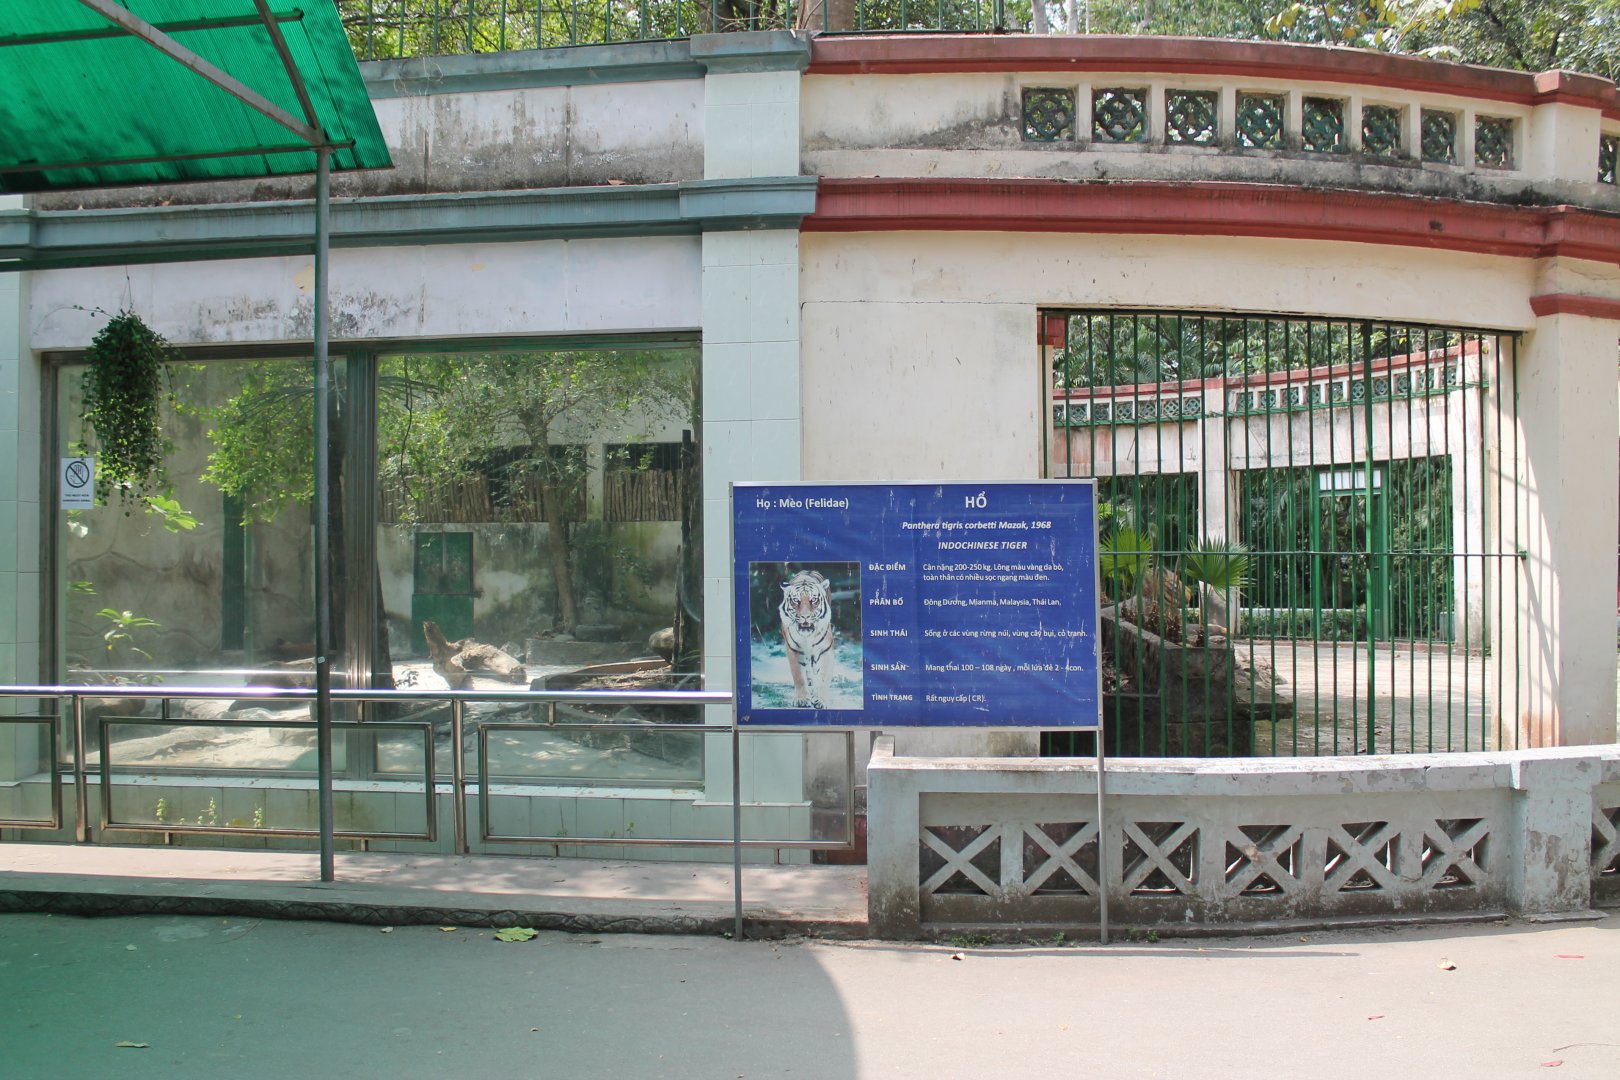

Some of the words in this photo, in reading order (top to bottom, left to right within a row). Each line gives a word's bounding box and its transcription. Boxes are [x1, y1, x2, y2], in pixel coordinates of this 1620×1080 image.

[965, 490, 987, 508] HỔ
[756, 498, 770, 510] Họ
[780, 498, 802, 508] Mèo
[805, 498, 848, 510] (Felidae)
[902, 521, 940, 530] Panthera
[942, 521, 963, 531] tigris
[965, 521, 996, 529] corbetti
[999, 521, 1028, 530] Mazak,
[938, 541, 999, 550] INDOCHINESE
[1001, 541, 1028, 550] TIGER
[869, 562, 884, 572] ĐẶC
[886, 562, 906, 571] ĐIỂM
[937, 564, 954, 572] nặng
[983, 564, 992, 572] kg.
[994, 564, 1010, 572] Lông
[1026, 563, 1043, 572] vàng
[870, 597, 890, 606] PHÂN
[893, 597, 904, 606] BỐ
[924, 599, 942, 607] Đông
[890, 628, 908, 636] THÁI
[924, 629, 941, 638] Sống
[962, 630, 978, 638] vùng
[980, 630, 997, 638] rừng
[1012, 630, 1029, 638] vùng
[890, 662, 906, 671] SẢN
[956, 694, 967, 703] cấp
